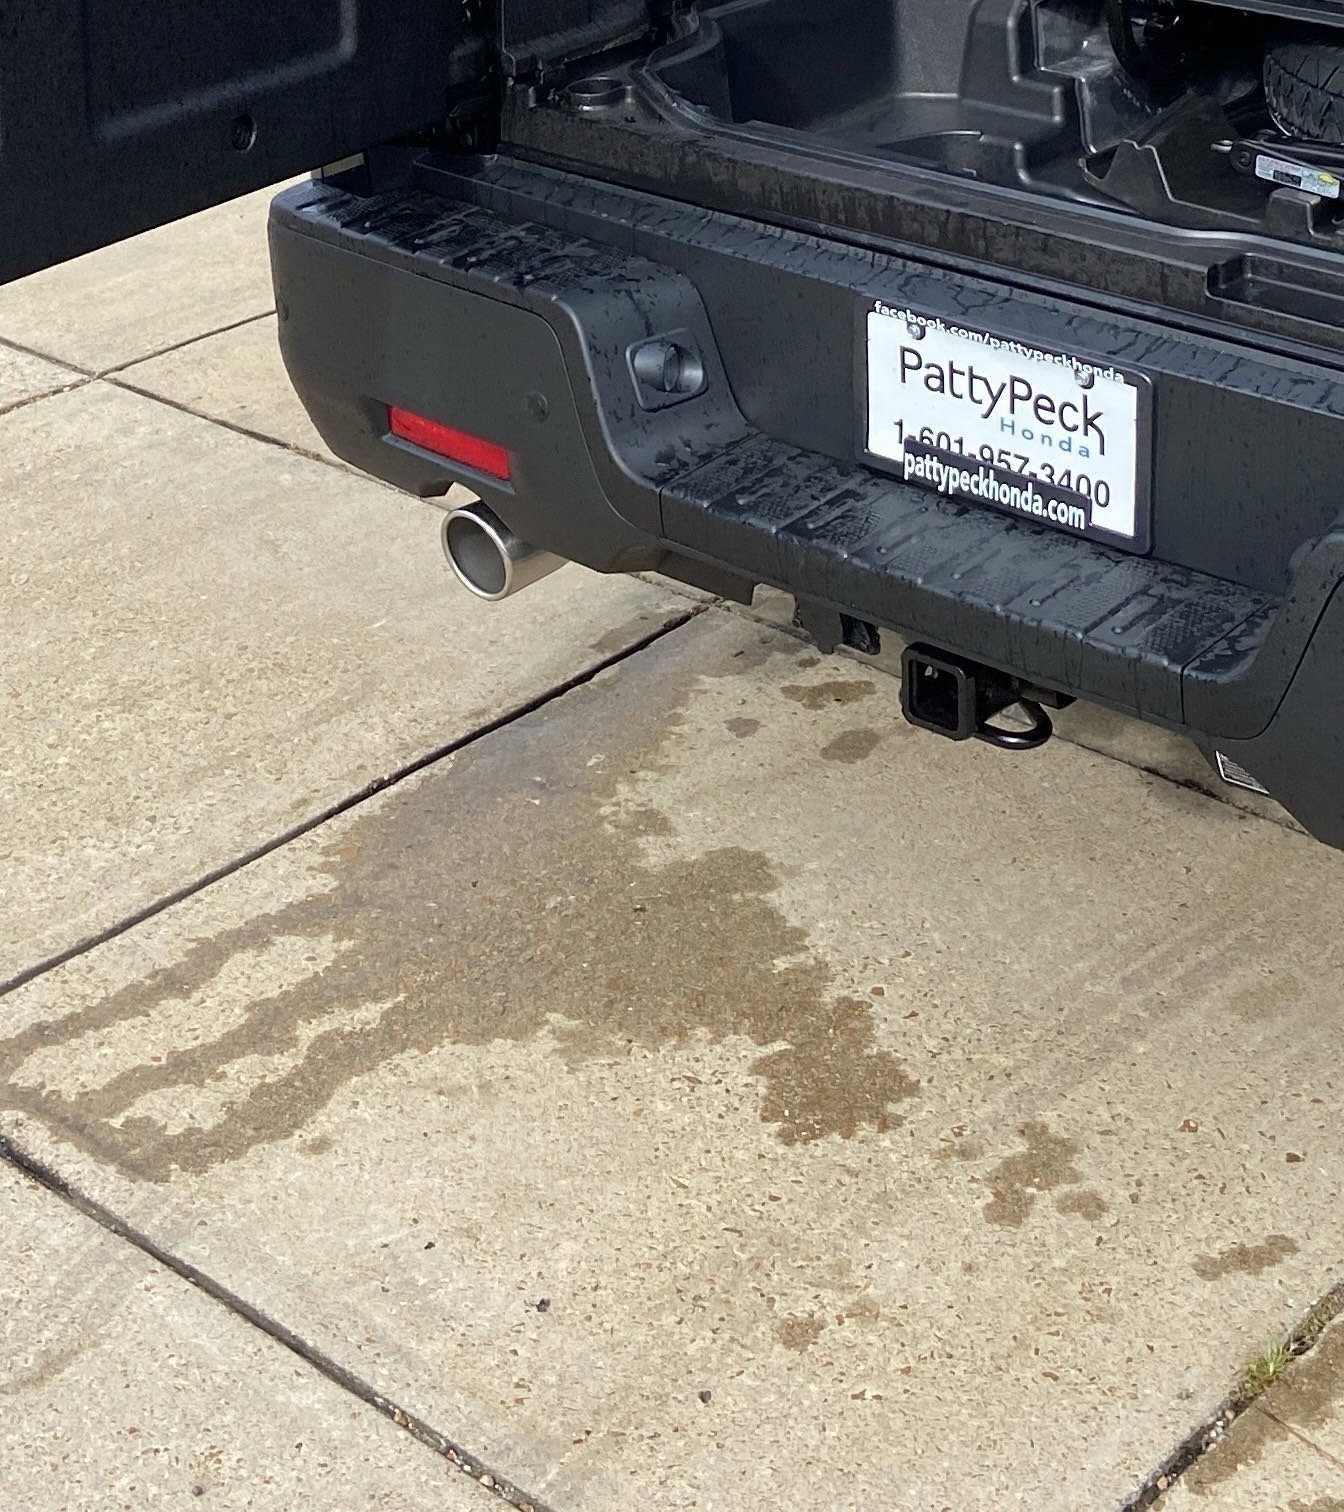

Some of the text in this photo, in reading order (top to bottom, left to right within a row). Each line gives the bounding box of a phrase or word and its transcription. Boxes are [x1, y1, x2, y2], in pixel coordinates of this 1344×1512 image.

[875, 301, 1124, 383] facebook.com/pattypeckhonda
[900, 345, 1105, 456] PattyPeck
[1000, 417, 1090, 458] Honda
[904, 452, 1086, 530] pattypeckhonda.com
